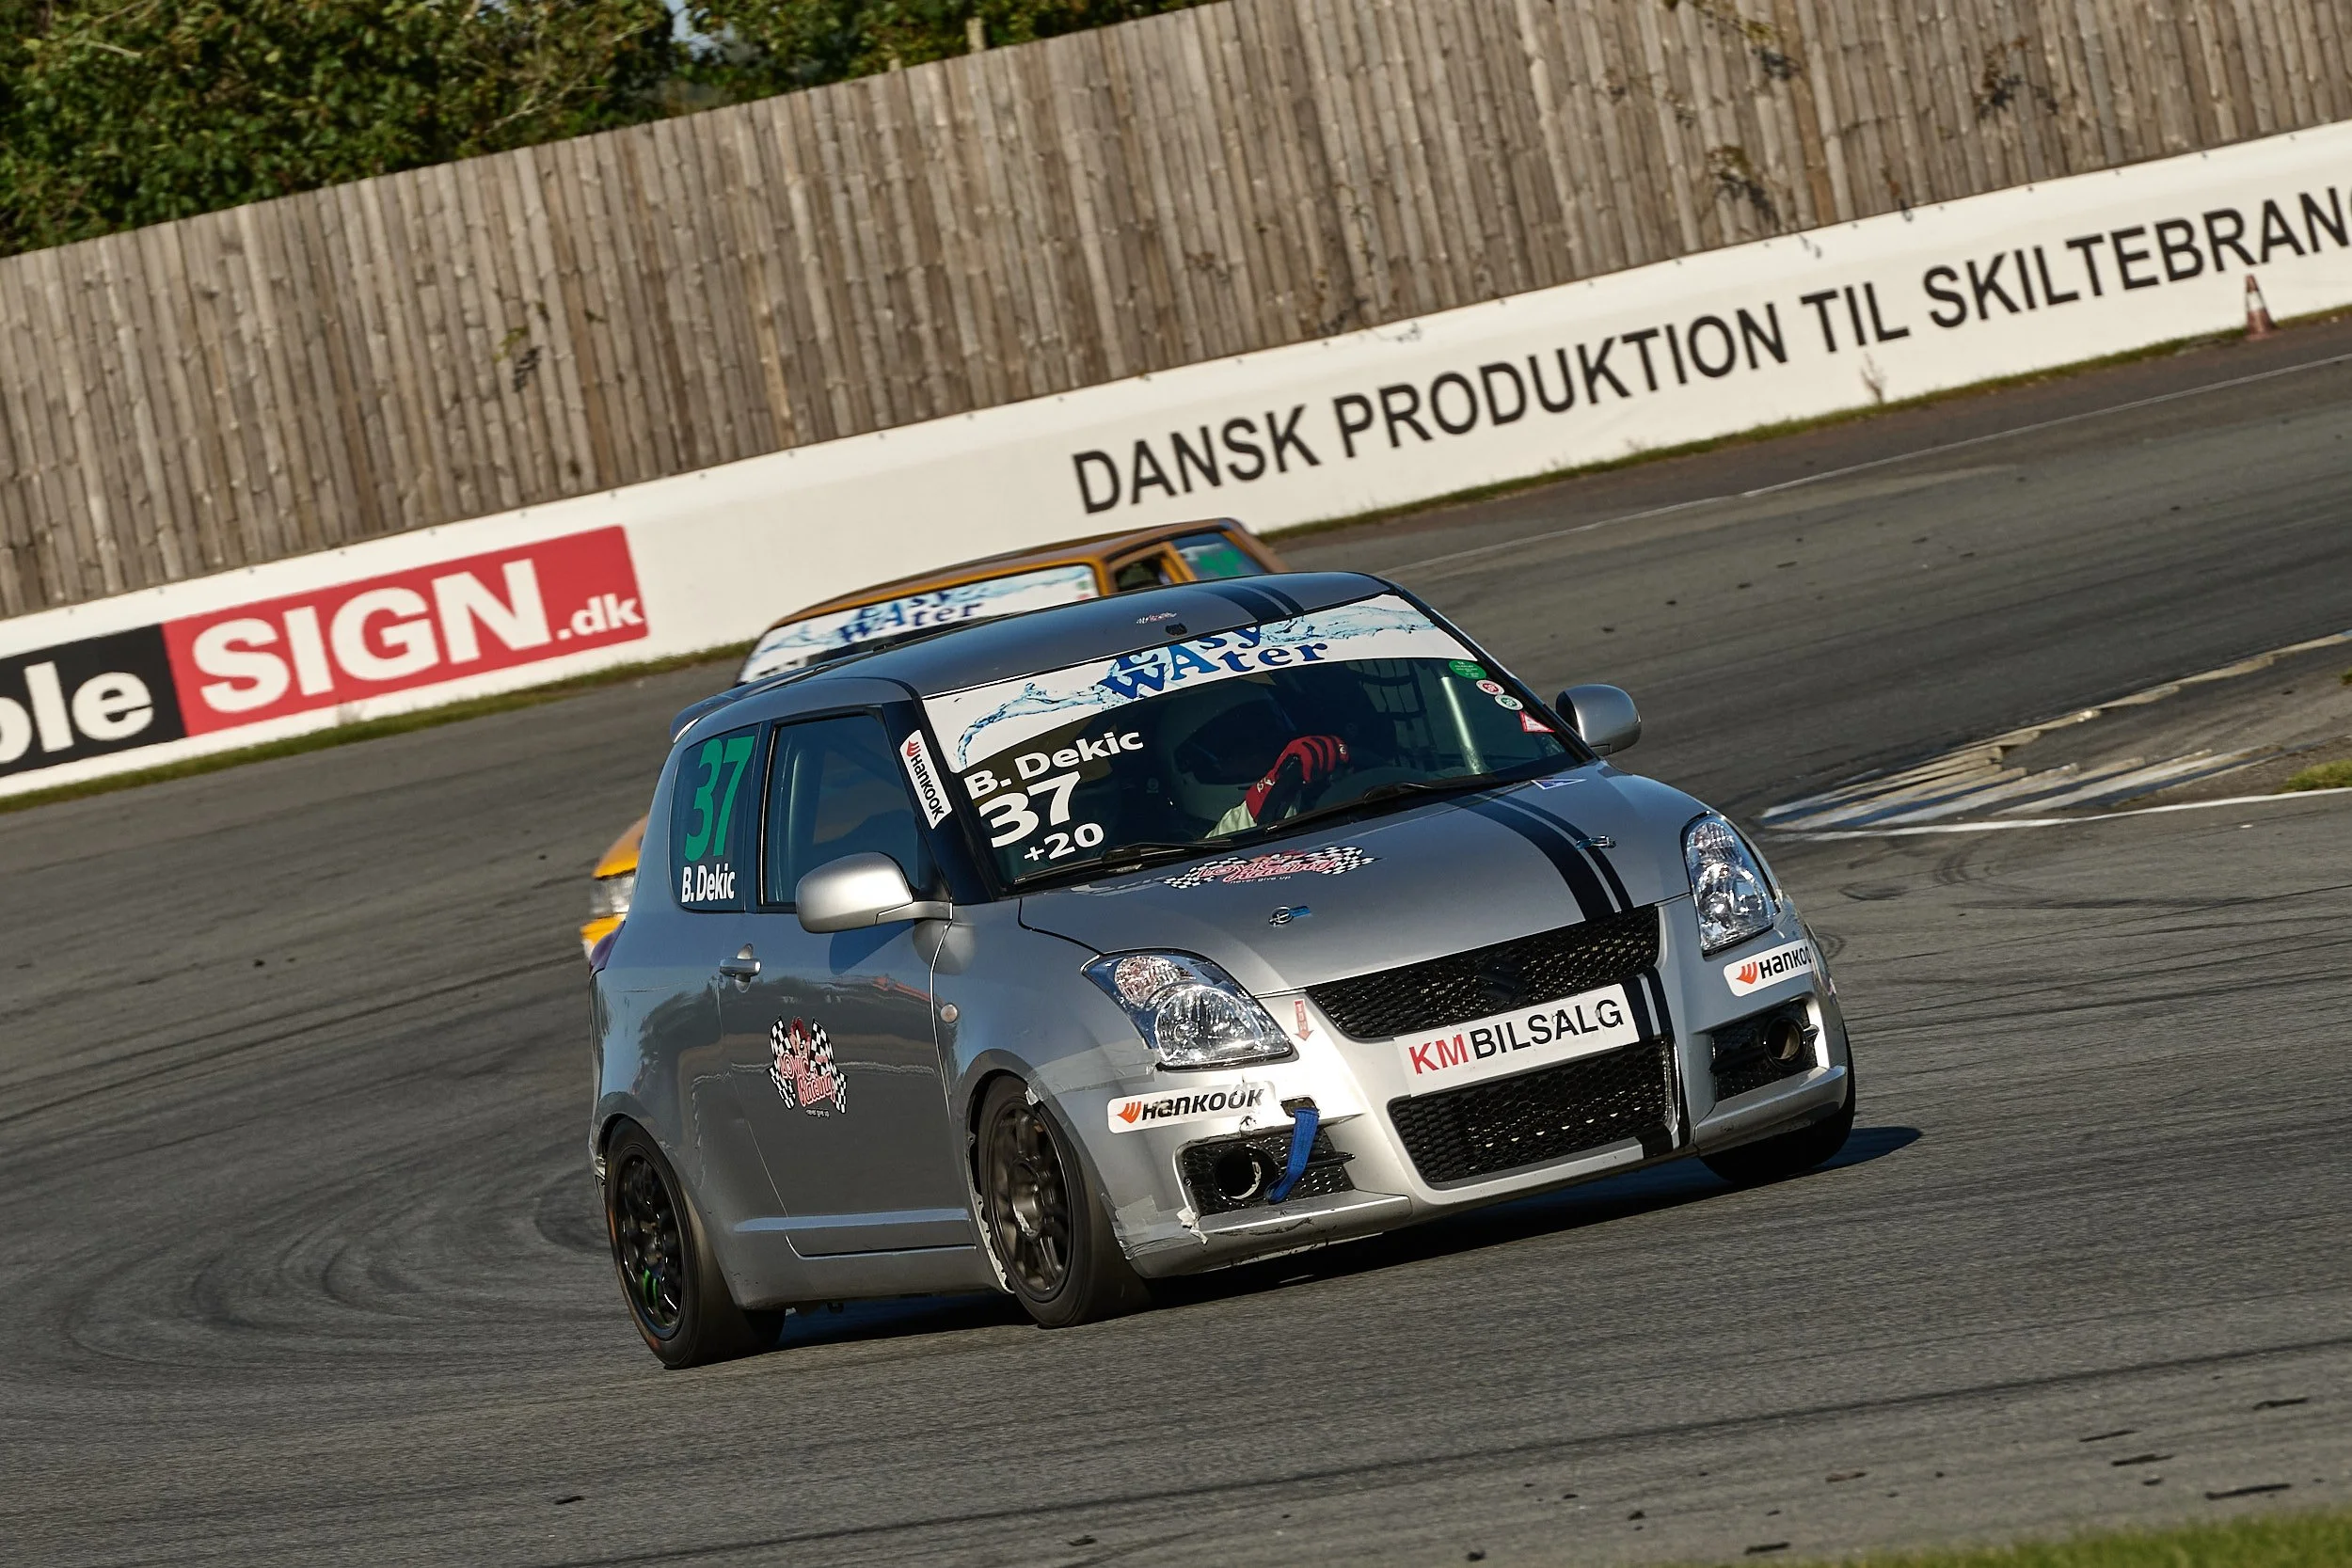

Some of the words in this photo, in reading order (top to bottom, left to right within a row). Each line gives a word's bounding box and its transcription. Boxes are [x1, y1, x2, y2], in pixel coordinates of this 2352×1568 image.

[1072, 404, 1319, 515] DANSK
[1332, 302, 1788, 459] PRODUKTION
[1801, 281, 1910, 353] TIL
[1922, 182, 2352, 328] SKILTEBRAN
[684, 736, 755, 862] 37
[964, 769, 1012, 800] B.
[1015, 732, 1143, 781] Dekic
[978, 770, 1081, 847] 37
[1024, 823, 1104, 862] +20
[696, 863, 736, 902] Dekic
